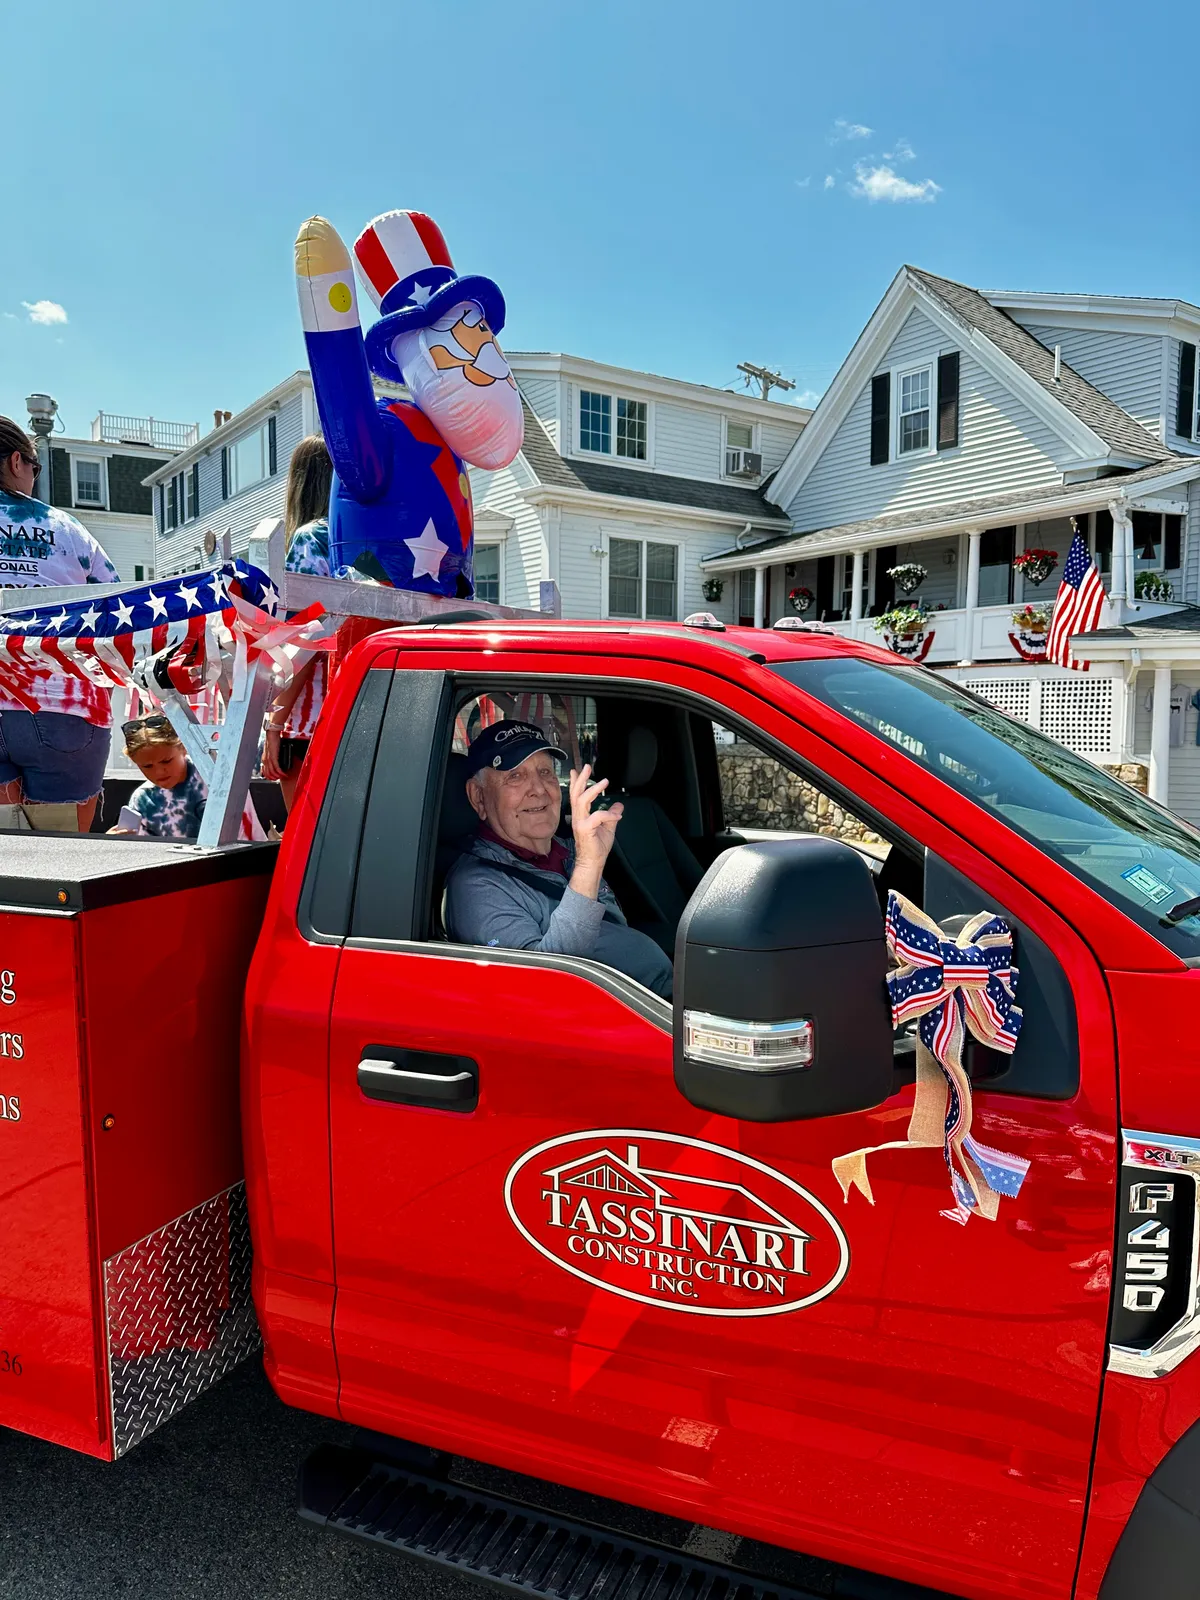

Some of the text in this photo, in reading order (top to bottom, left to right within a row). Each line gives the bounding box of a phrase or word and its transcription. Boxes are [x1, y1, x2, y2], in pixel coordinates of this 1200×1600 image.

[0, 525, 55, 546] NARI
[0, 562, 38, 572] ONALS
[1144, 1149, 1194, 1165] XLT
[542, 1190, 810, 1275] TASSINARI
[567, 1235, 786, 1296] CONSTRUCTION
[650, 1273, 699, 1299] INC.
